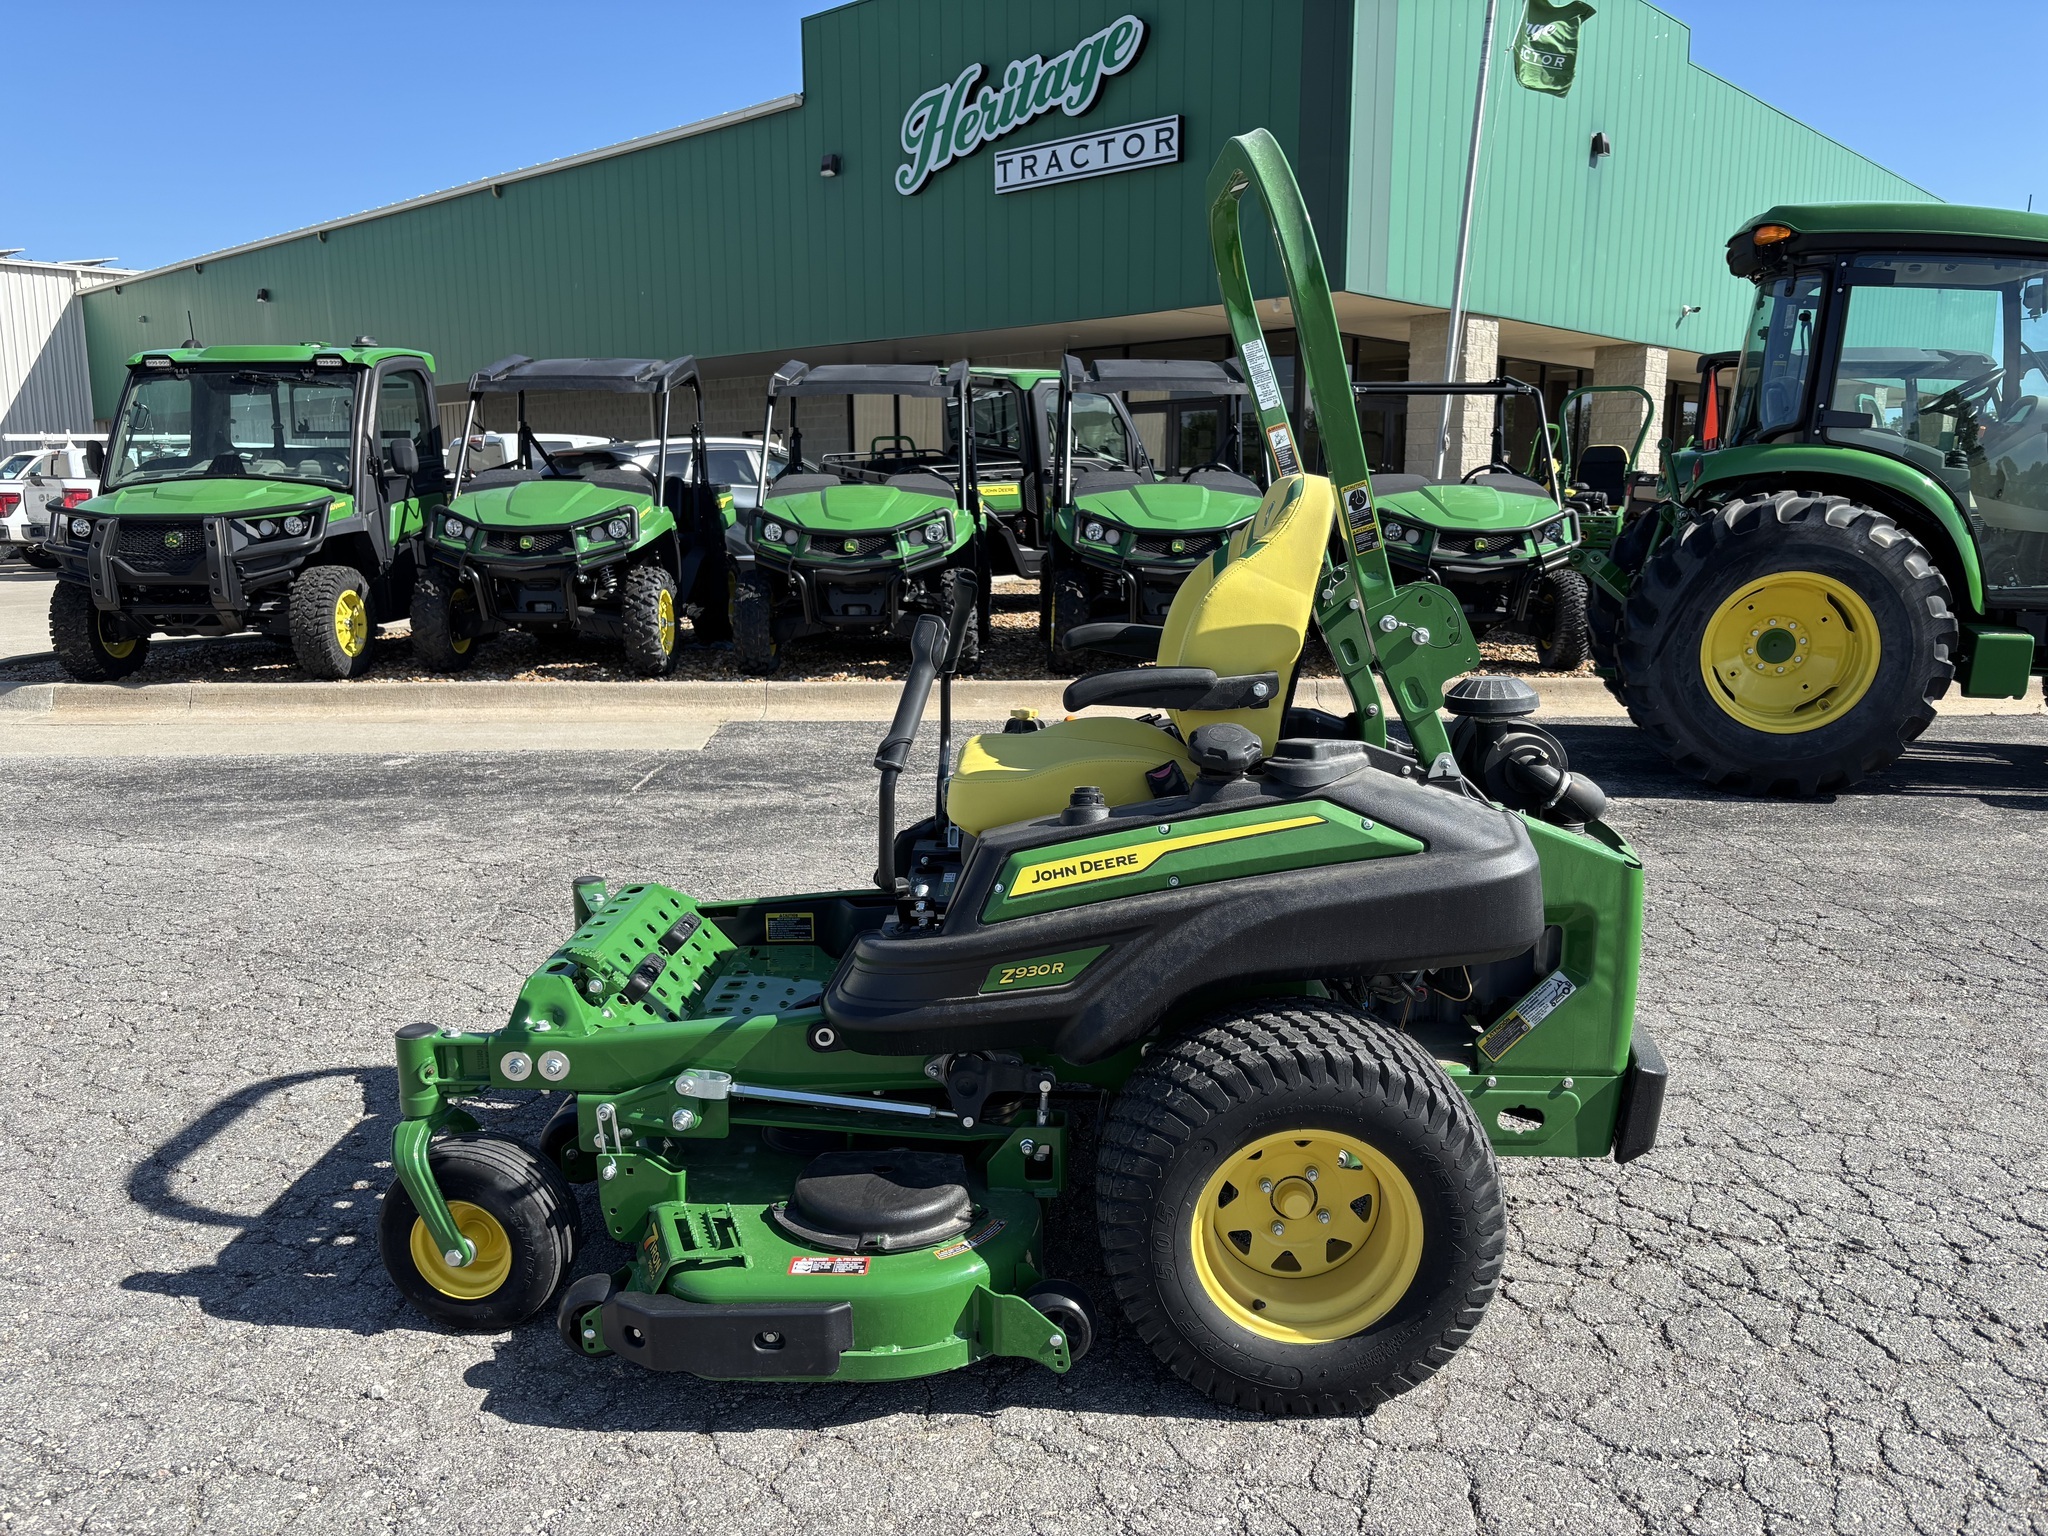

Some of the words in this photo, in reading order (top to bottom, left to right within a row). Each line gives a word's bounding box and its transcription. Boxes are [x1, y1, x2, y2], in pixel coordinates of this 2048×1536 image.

[896, 15, 1144, 195] Heritage
[996, 126, 1175, 184] TRACTOR
[1031, 865, 1077, 884] JOHN
[1080, 853, 1139, 874] DEERE
[999, 962, 1064, 985] Z930R
[1152, 1200, 1177, 1281] 505
